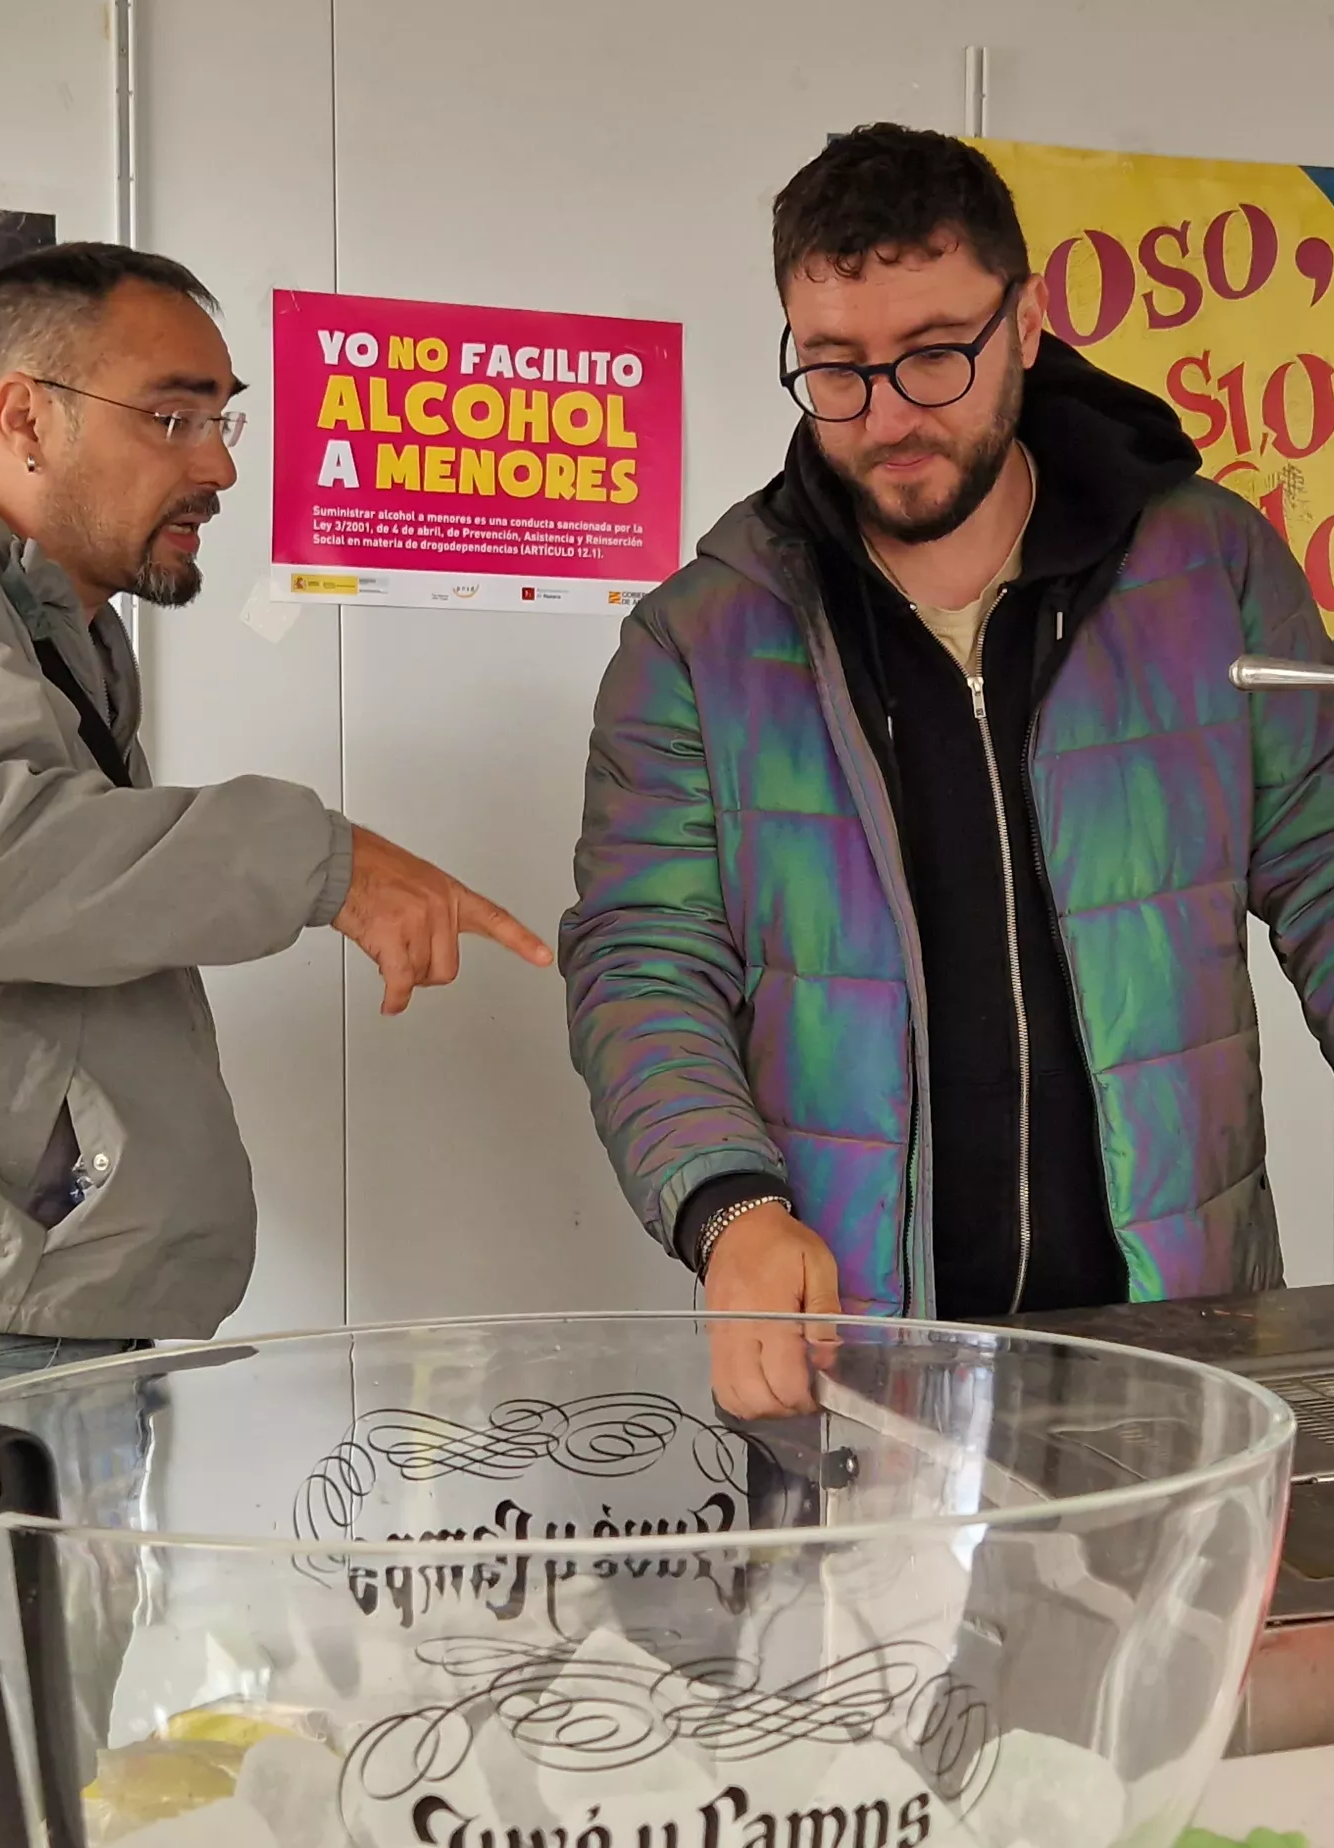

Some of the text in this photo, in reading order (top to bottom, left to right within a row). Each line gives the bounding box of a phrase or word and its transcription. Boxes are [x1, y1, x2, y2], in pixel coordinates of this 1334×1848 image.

[317, 330, 643, 388] YO NO FACILITO
[317, 374, 638, 449] ALCOHOL
[317, 439, 639, 504] A MENORES
[313, 505, 643, 536] Suministrar alcohol a menores es una conducta sancionada por la
[313, 521, 643, 547] Ley 3/2001, de 4 de abril, de Prevención, Asistencia y Reinserción
[313, 534, 345, 545] Social
[347, 537, 361, 546] en
[362, 536, 403, 548] materia
[405, 537, 418, 549] de
[420, 538, 519, 555] drogodependencias
[520, 543, 575, 558] (ARTÍCULO
